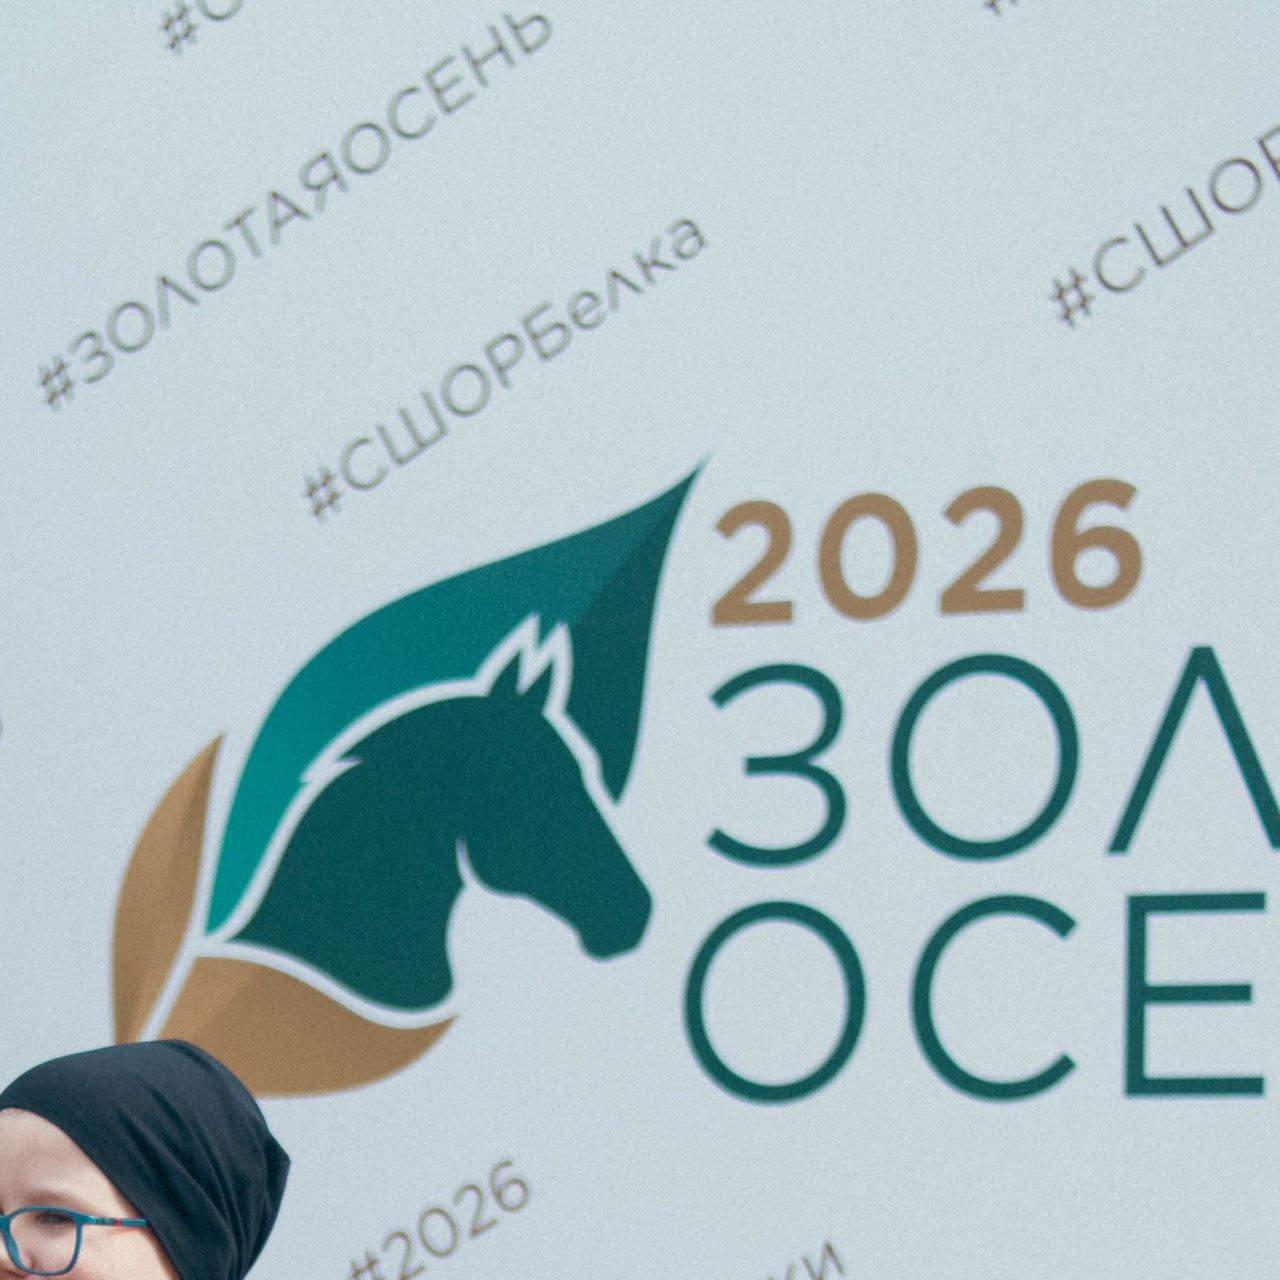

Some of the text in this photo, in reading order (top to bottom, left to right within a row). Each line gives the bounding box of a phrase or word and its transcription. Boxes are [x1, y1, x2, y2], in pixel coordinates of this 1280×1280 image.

[37, 10, 552, 411] #ЗОЛОТАЯОСЕНЬ
[301, 217, 707, 522] #СШОРБелка
[709, 477, 1144, 628] 2026
[704, 644, 1280, 870] ЗОЛ
[681, 890, 1267, 1106] ОСЕ
